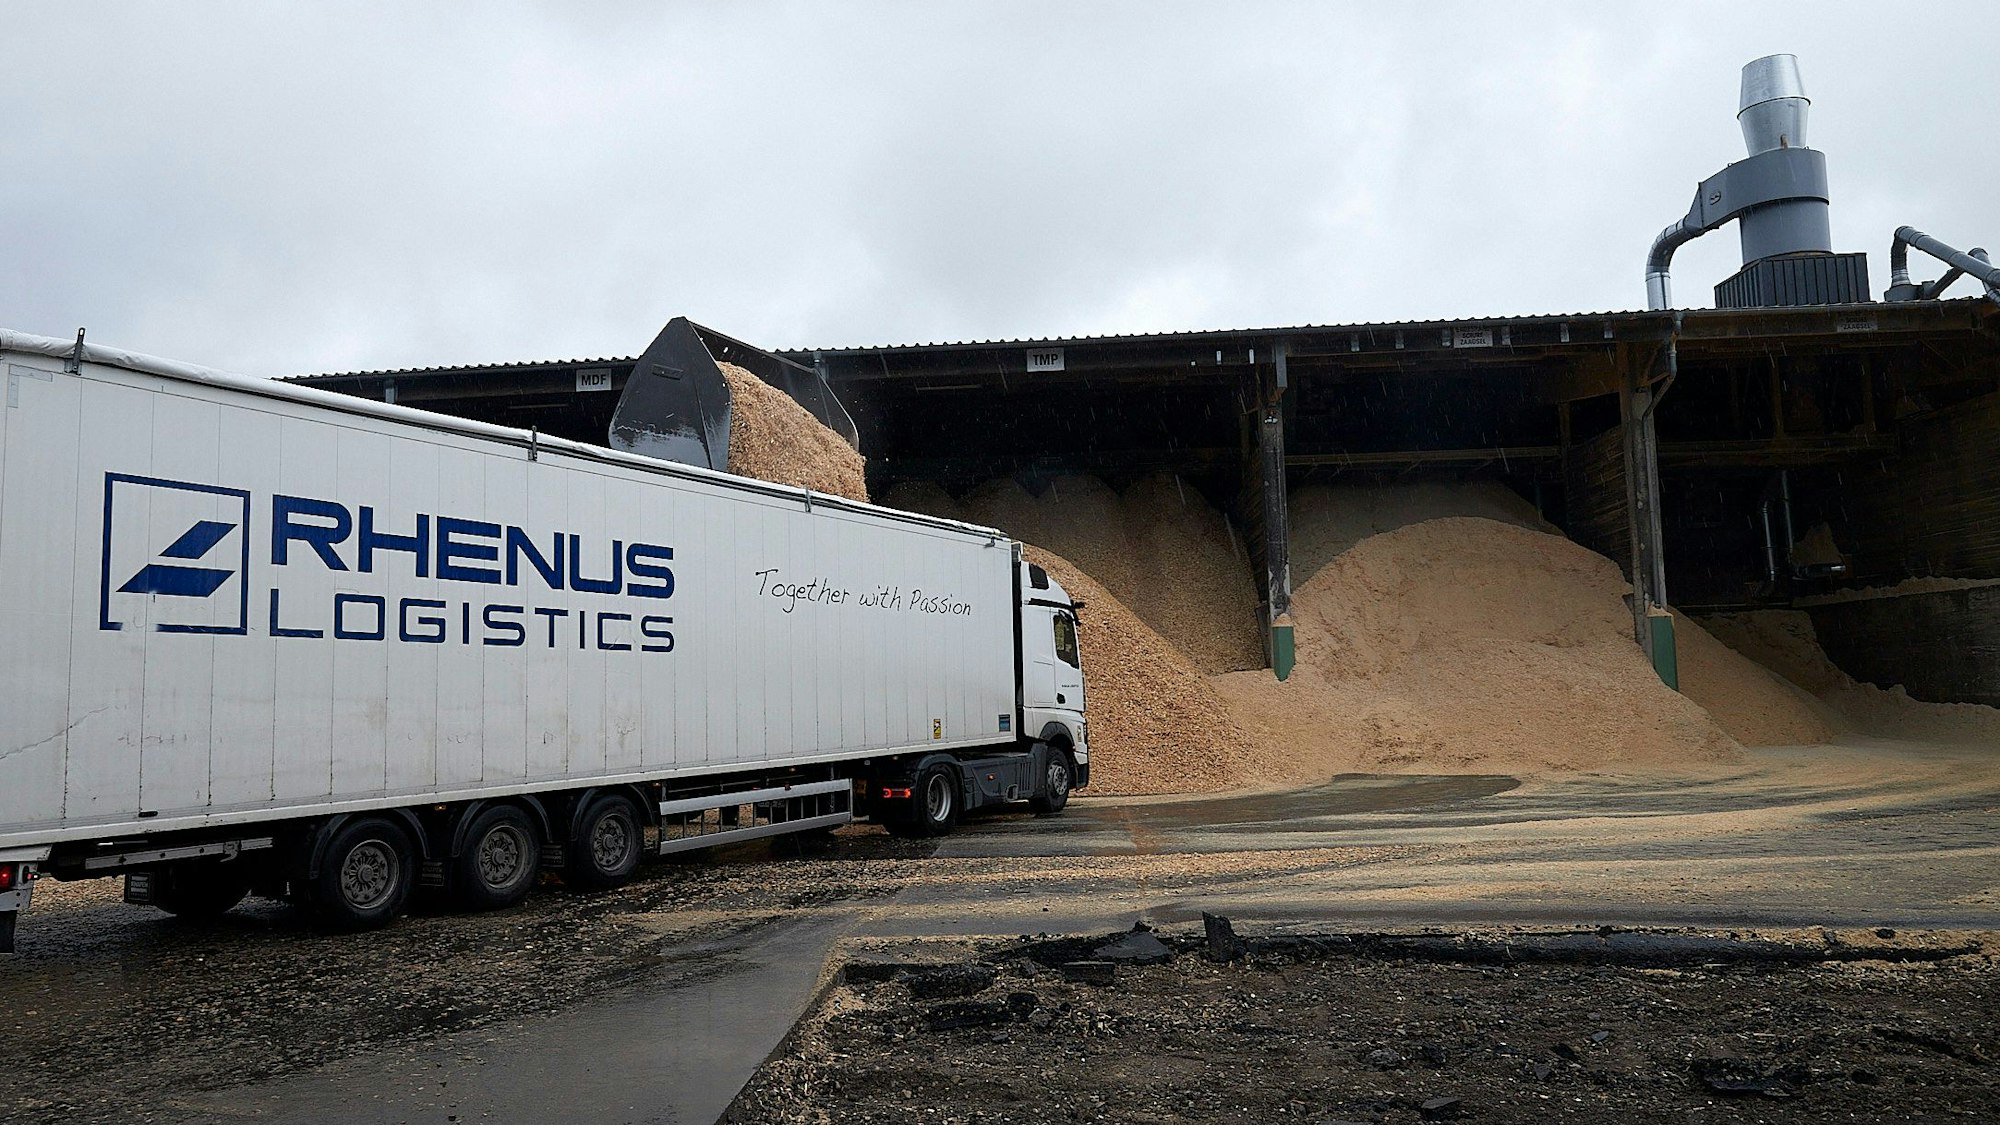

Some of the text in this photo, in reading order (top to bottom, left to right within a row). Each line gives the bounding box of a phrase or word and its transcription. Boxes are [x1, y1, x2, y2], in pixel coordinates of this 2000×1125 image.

[581, 374, 607, 386] MDF
[1032, 353, 1059, 366] TMP
[271, 494, 675, 599] RHENUS
[755, 569, 971, 616] Together with Passion
[269, 588, 675, 653] LOGISTICS
